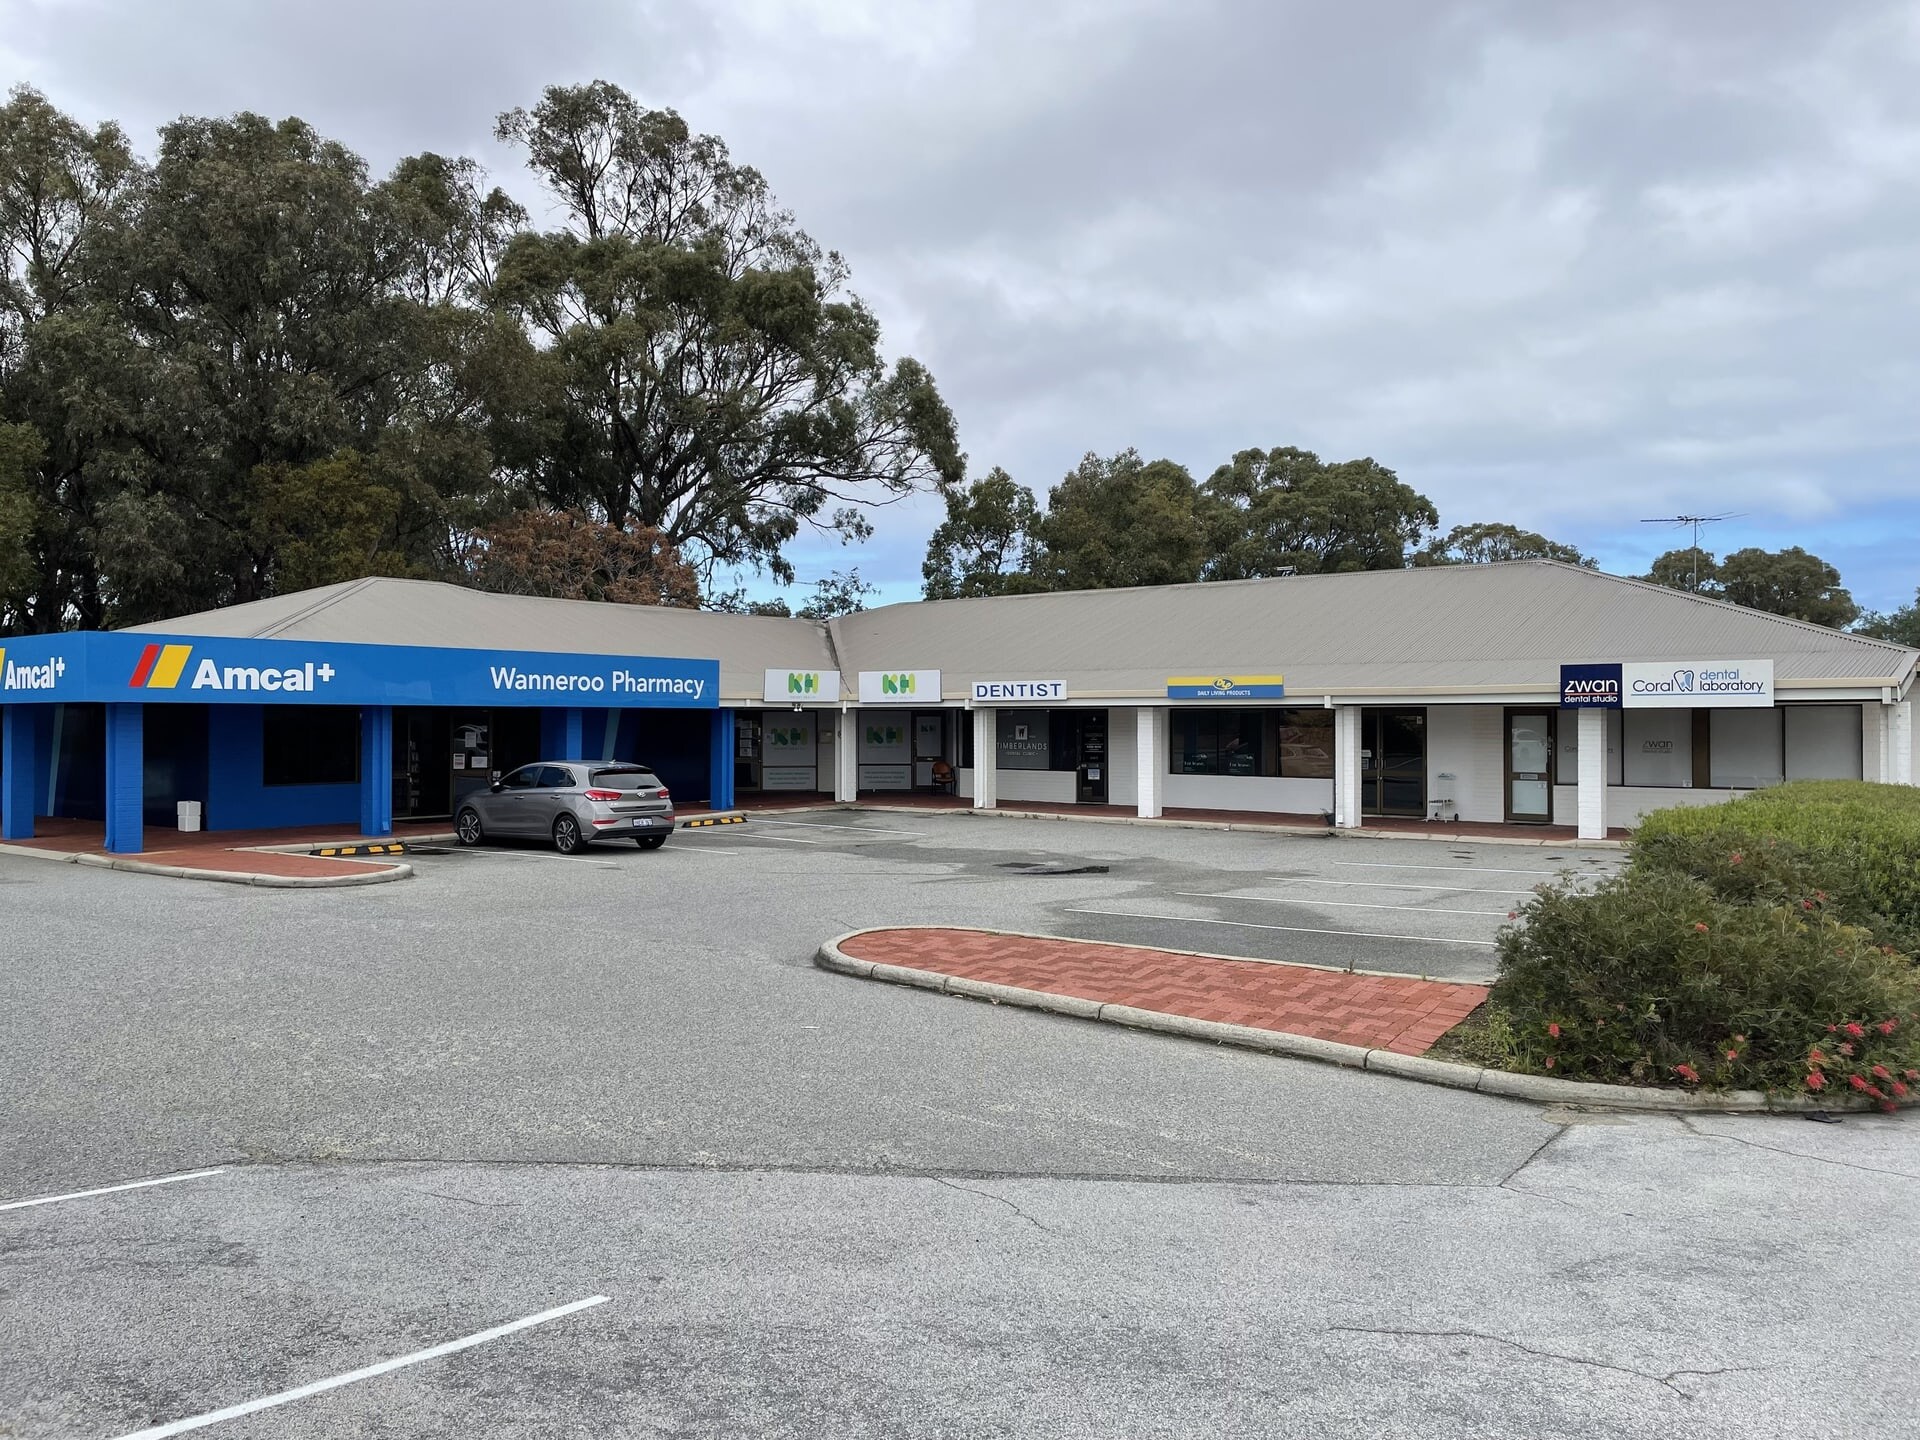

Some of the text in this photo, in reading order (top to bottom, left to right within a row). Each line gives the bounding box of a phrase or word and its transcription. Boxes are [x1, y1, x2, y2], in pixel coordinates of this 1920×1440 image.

[4, 656, 66, 690] Amcal+
[191, 658, 335, 692] Amcal+
[1699, 668, 1740, 681] dental
[490, 666, 705, 700] Wanneroo Pharmacy
[788, 672, 819, 694] KH
[882, 673, 916, 694] KH
[976, 683, 1062, 698] DENTIST
[1564, 678, 1618, 693] zwan
[1632, 679, 1674, 693] Coral
[1699, 679, 1764, 693] laboratory
[1564, 695, 1618, 703] dental studio
[996, 742, 1048, 751] TIMBERLANDS
